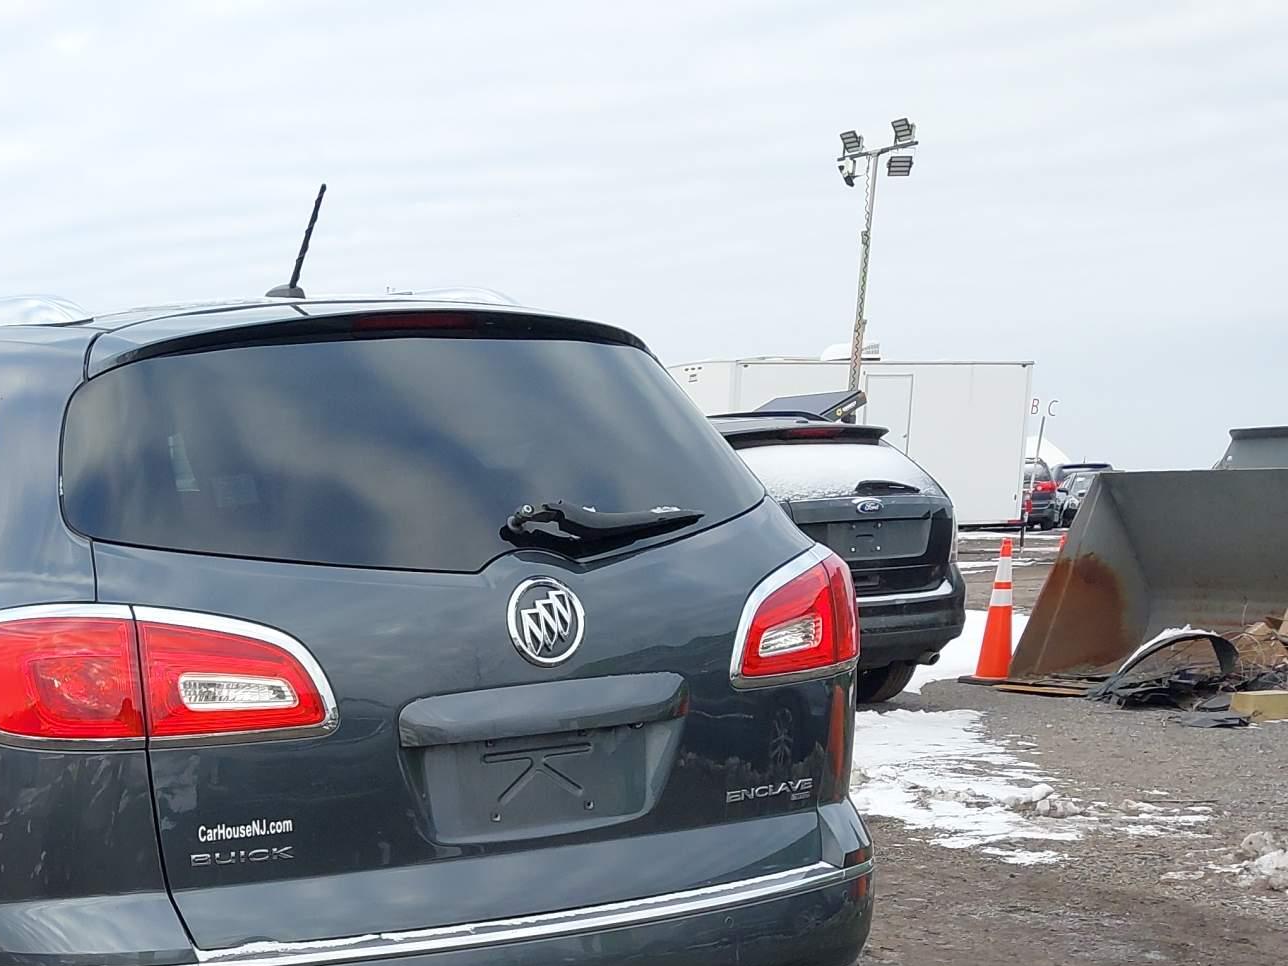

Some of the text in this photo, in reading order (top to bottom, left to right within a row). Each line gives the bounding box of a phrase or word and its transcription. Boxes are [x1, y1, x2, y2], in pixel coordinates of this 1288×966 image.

[1031, 398, 1060, 417] B C
[726, 778, 813, 803] ENCLAVE
[198, 818, 293, 843] CarHouseNJ.com
[190, 845, 295, 867] BUICK
